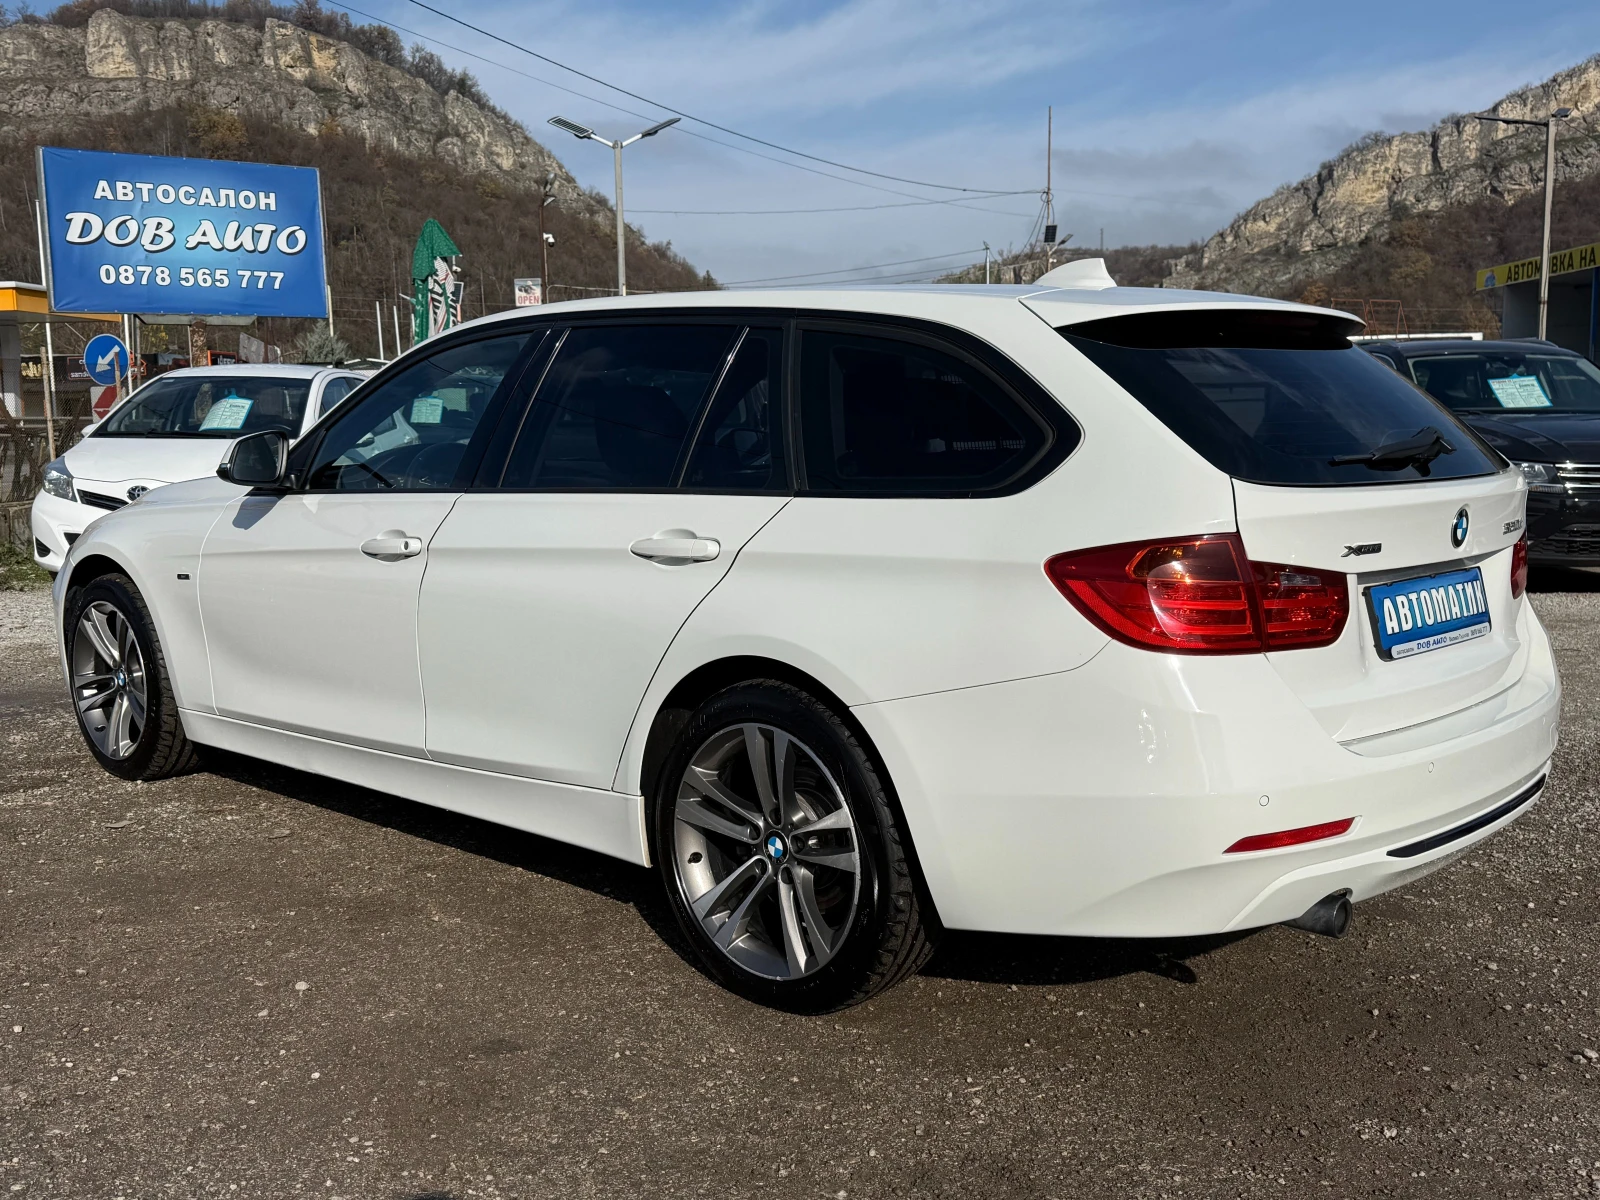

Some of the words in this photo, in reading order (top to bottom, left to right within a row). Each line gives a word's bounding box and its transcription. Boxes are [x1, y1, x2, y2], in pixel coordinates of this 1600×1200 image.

[94, 180, 277, 211] АВТОСАЛОН
[65, 212, 175, 253] DOB
[186, 219, 308, 254] AUTO
[99, 264, 171, 287] 0878
[179, 267, 230, 289] 565
[238, 269, 285, 291] 777
[1506, 253, 1574, 283] АВТОМВКА
[1579, 246, 1597, 268] НА
[518, 295, 540, 304] OPEN
[1382, 579, 1487, 636] АВТОМАТИК
